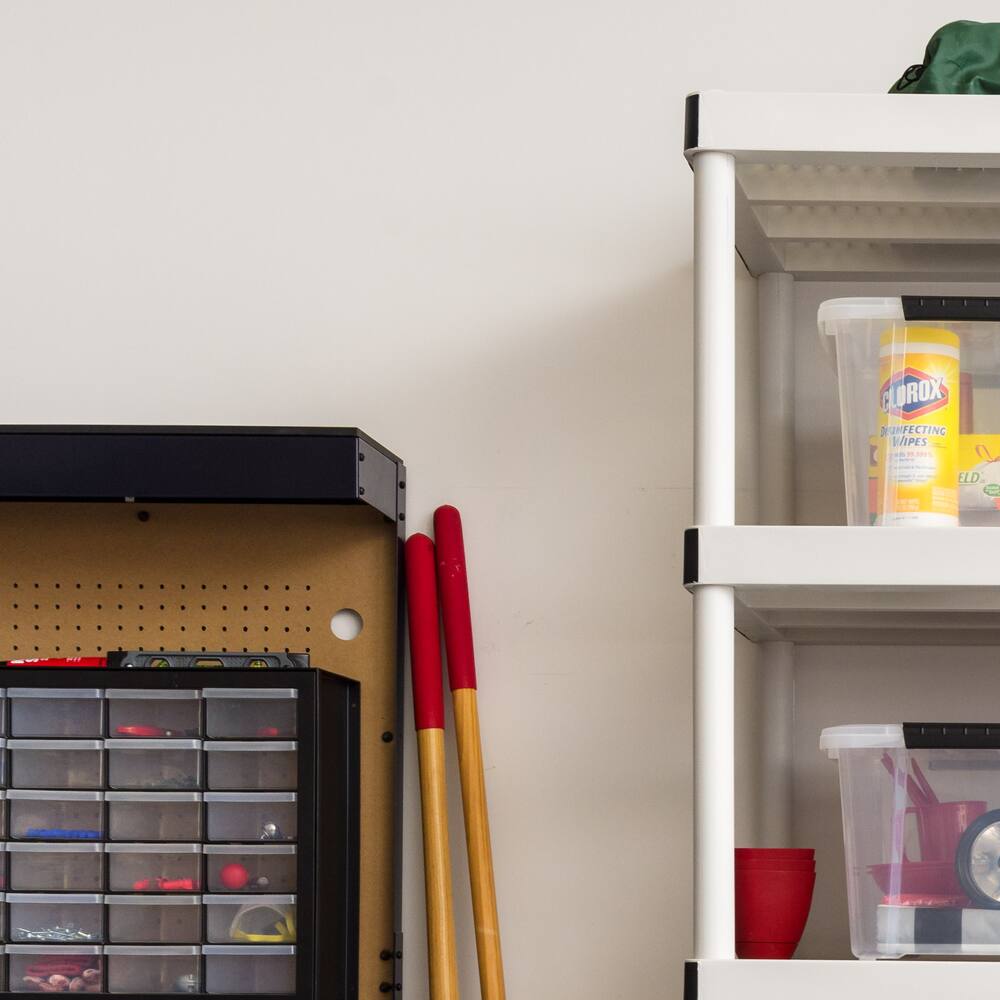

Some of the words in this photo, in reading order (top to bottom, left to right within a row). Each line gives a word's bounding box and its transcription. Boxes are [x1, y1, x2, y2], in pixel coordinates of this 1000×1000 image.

[882, 376, 944, 413] CLOROX
[892, 435, 928, 448] WIPES
[958, 471, 980, 484] ELD
